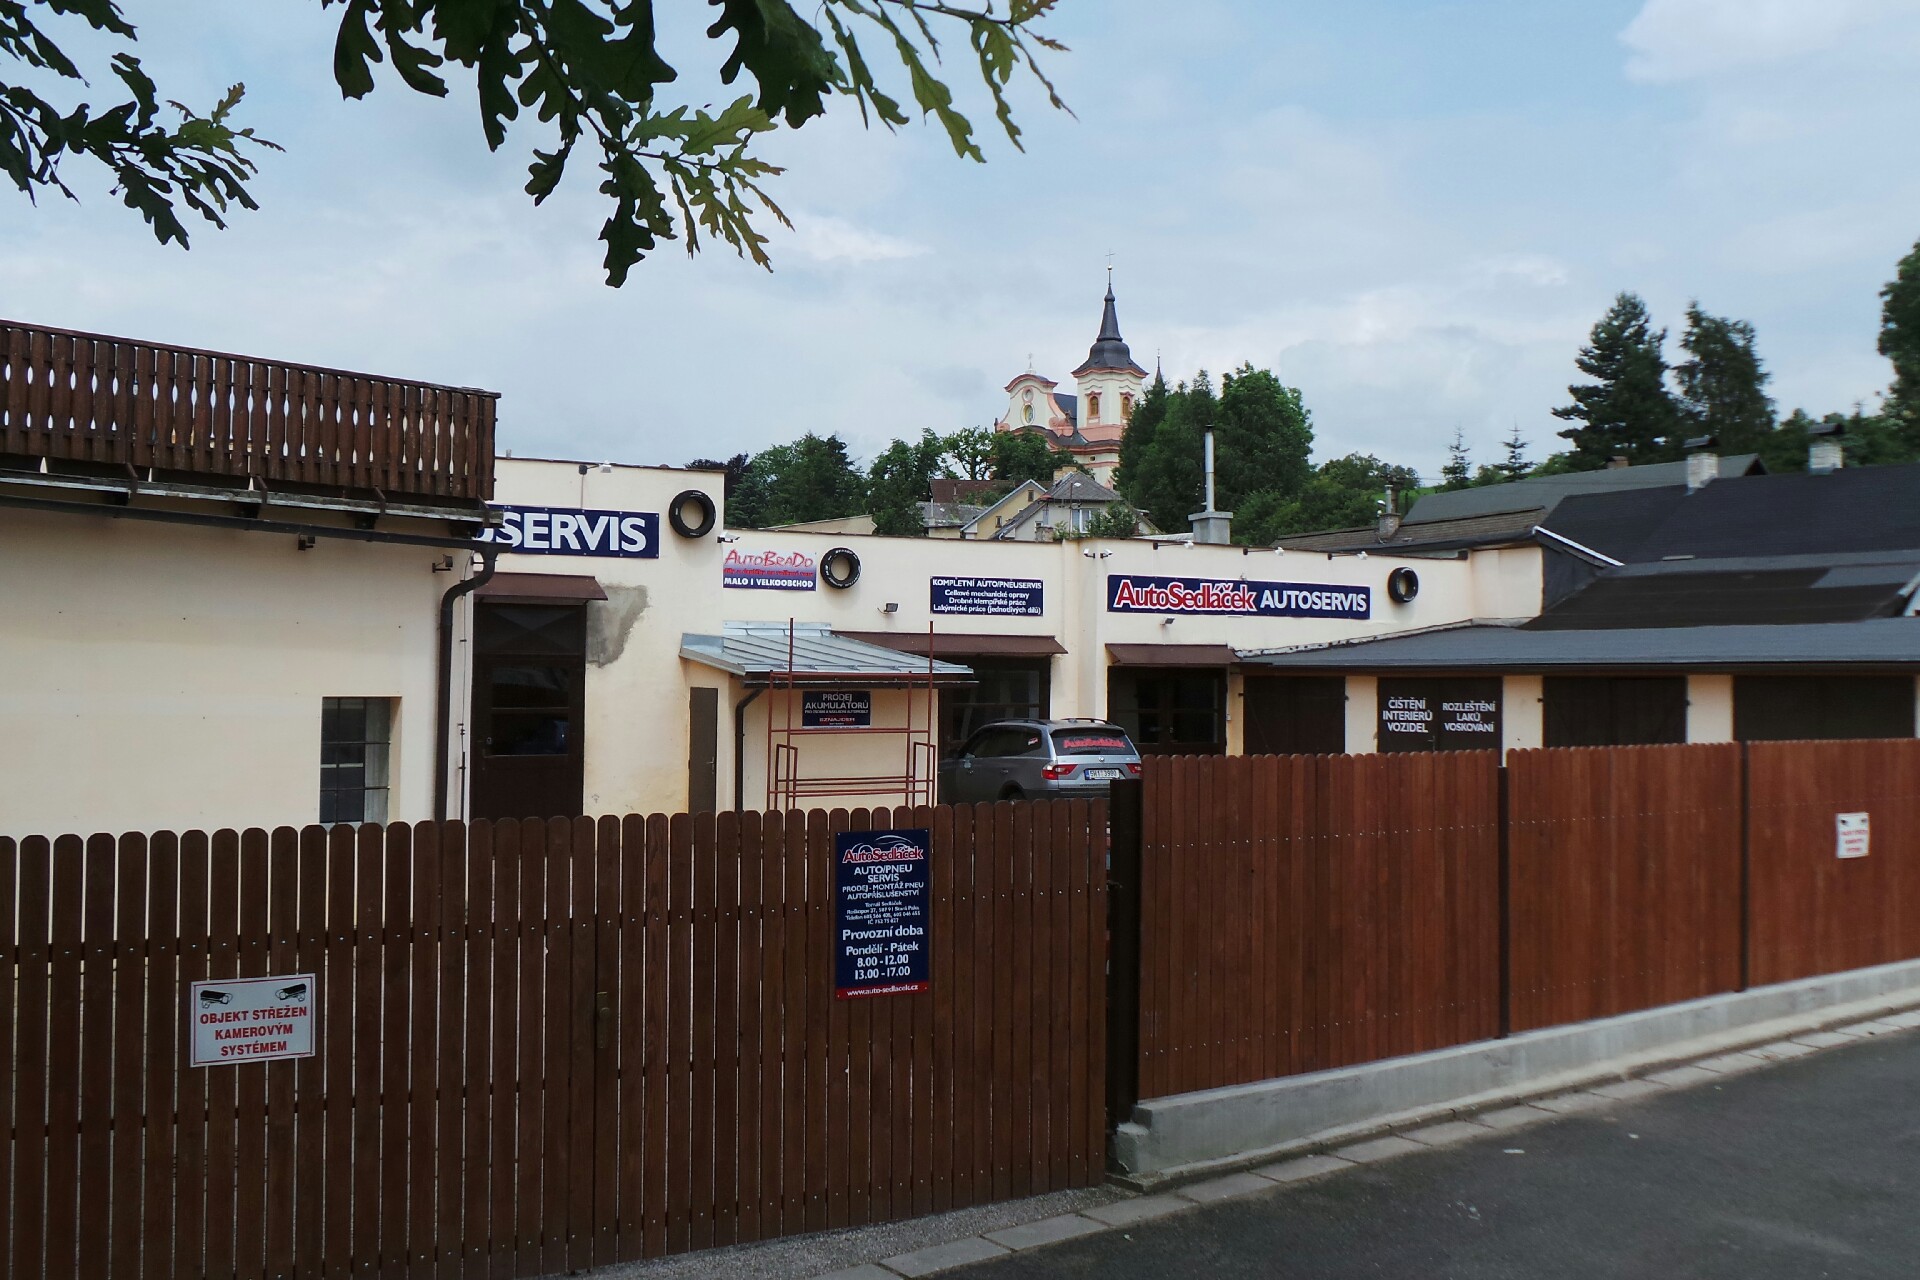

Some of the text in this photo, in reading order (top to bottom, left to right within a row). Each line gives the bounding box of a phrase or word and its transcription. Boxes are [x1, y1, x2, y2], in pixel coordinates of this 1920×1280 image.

[724, 577, 749, 586] MALO
[755, 578, 814, 588] VELKOOBCHOD
[932, 578, 1042, 590] KOMPLETNÍ AUTO/PNEUSERVIS
[944, 589, 1030, 600] Celkové mechanické opravy
[1113, 579, 1368, 612] AutoSedláček AUTOSERVIS
[968, 605, 987, 613] práce
[1008, 599, 1027, 607] práce
[822, 693, 853, 701] PRODEJ
[1388, 696, 1427, 710] ČIŠTĚNÍ
[804, 700, 869, 709] AKUMULÁTORŮ
[1456, 712, 1481, 722] LAKŮ
[1387, 722, 1429, 733] VOZIDEL
[1444, 721, 1495, 733] VOSKOVÁNÍ
[842, 845, 924, 863] AutoSedláček
[854, 864, 913, 875] AUTO/PNEU
[867, 873, 900, 884] SERVIS
[842, 884, 869, 893] PRODEJ
[872, 881, 904, 891] MONTÁŽ
[904, 881, 924, 890] PNEU
[842, 924, 924, 941] Provozní doba
[846, 943, 883, 956] Pondělí
[890, 941, 919, 953] Pátek
[856, 956, 878, 968] 8.00
[885, 954, 909, 965] 12.00
[854, 968, 879, 980] 13.00
[887, 966, 911, 977] 17.00
[200, 1005, 307, 1024] OBJEKT STŘEŽEN
[215, 1022, 293, 1040] KAMEROVÝM
[220, 1040, 287, 1056] SYSTÉMEM
